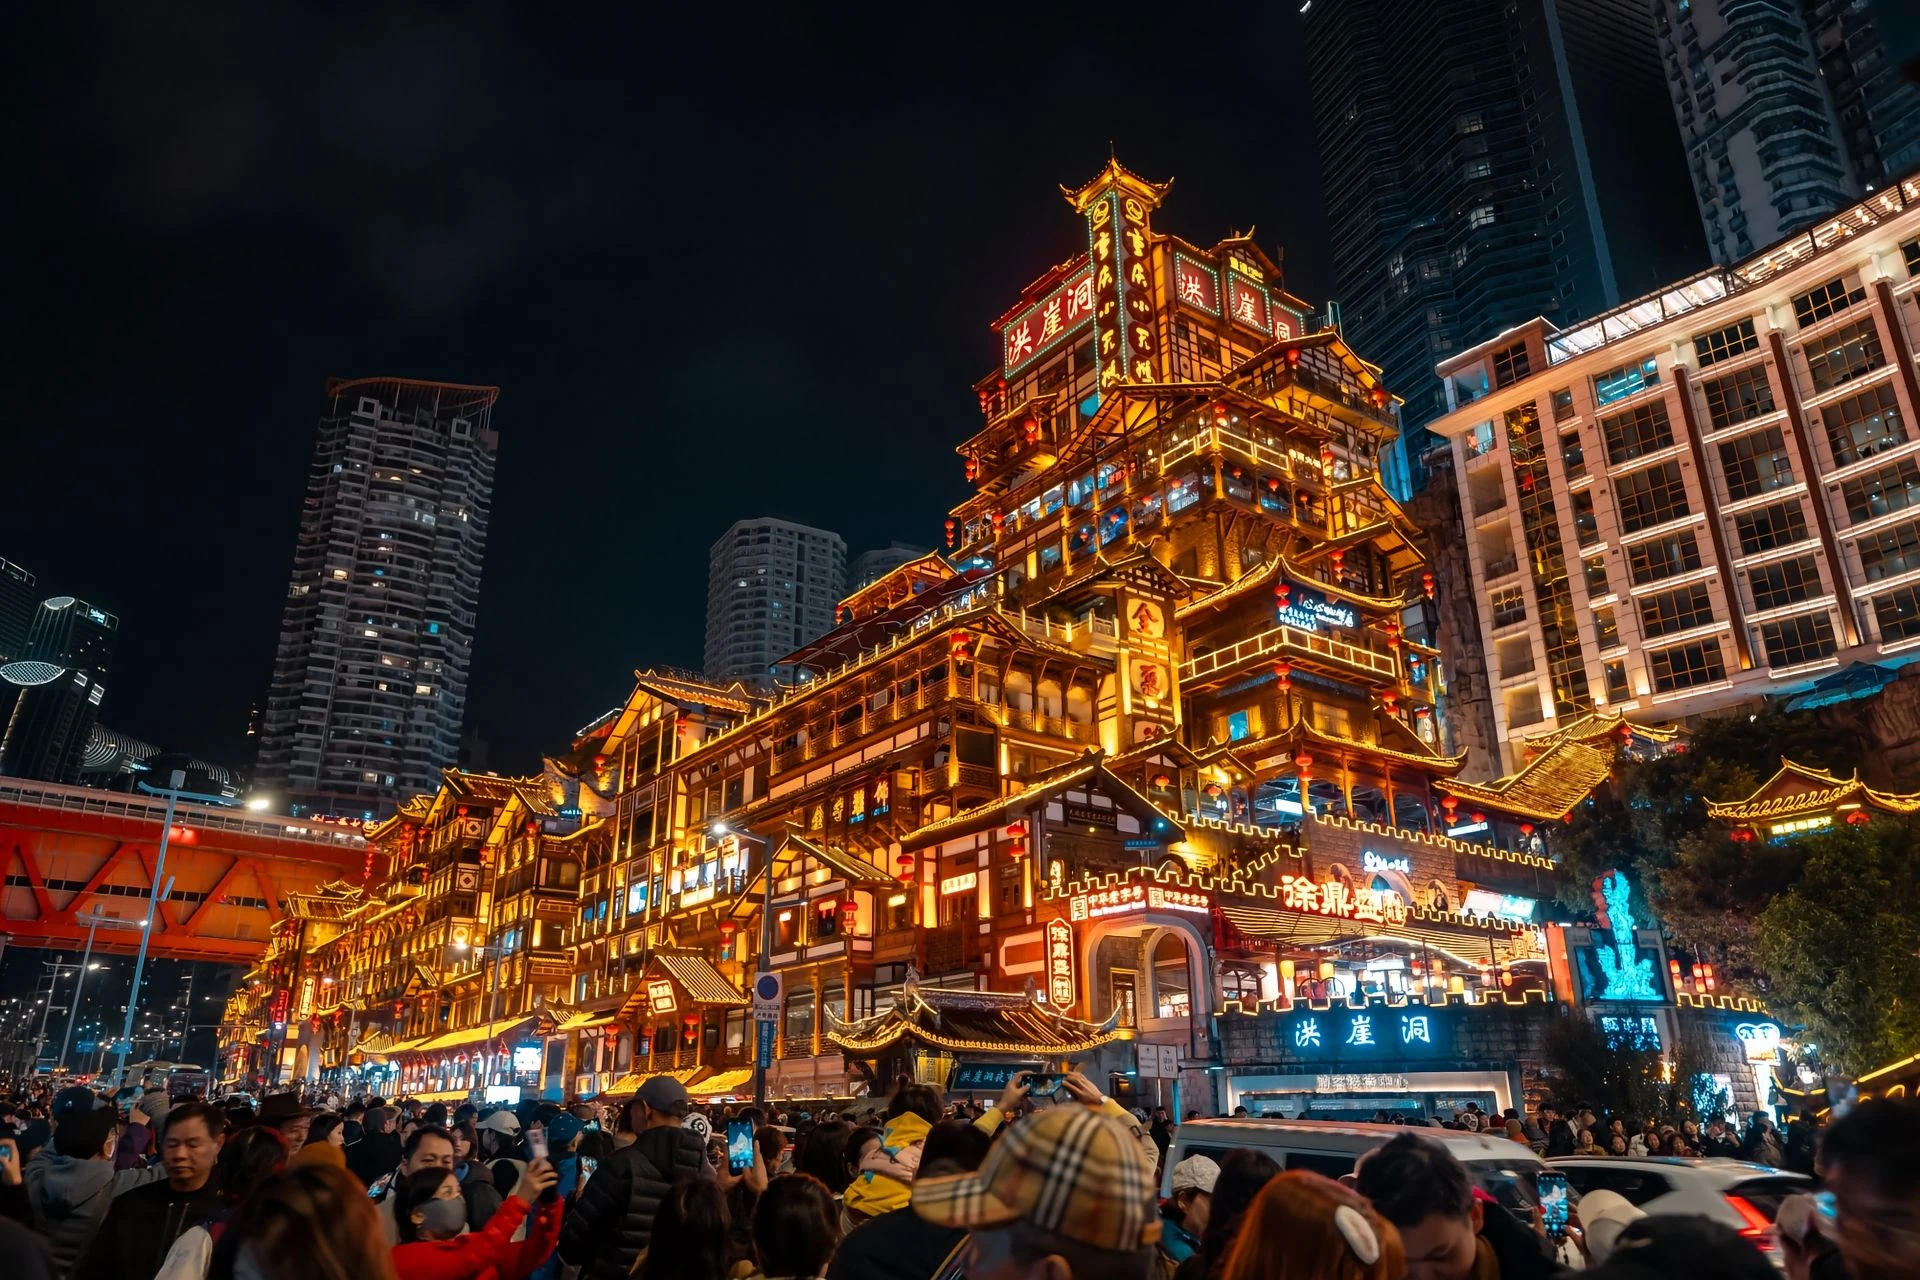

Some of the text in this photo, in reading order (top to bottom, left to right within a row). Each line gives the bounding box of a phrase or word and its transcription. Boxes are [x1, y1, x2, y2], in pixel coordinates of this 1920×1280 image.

[1008, 277, 1093, 366] 洪崖洞
[1088, 885, 1144, 908] 中华老字号
[1164, 890, 1209, 907] 中华老字号
[1281, 875, 1384, 924] 徐鼎盛
[1295, 1014, 1431, 1048] 洪崖洞
